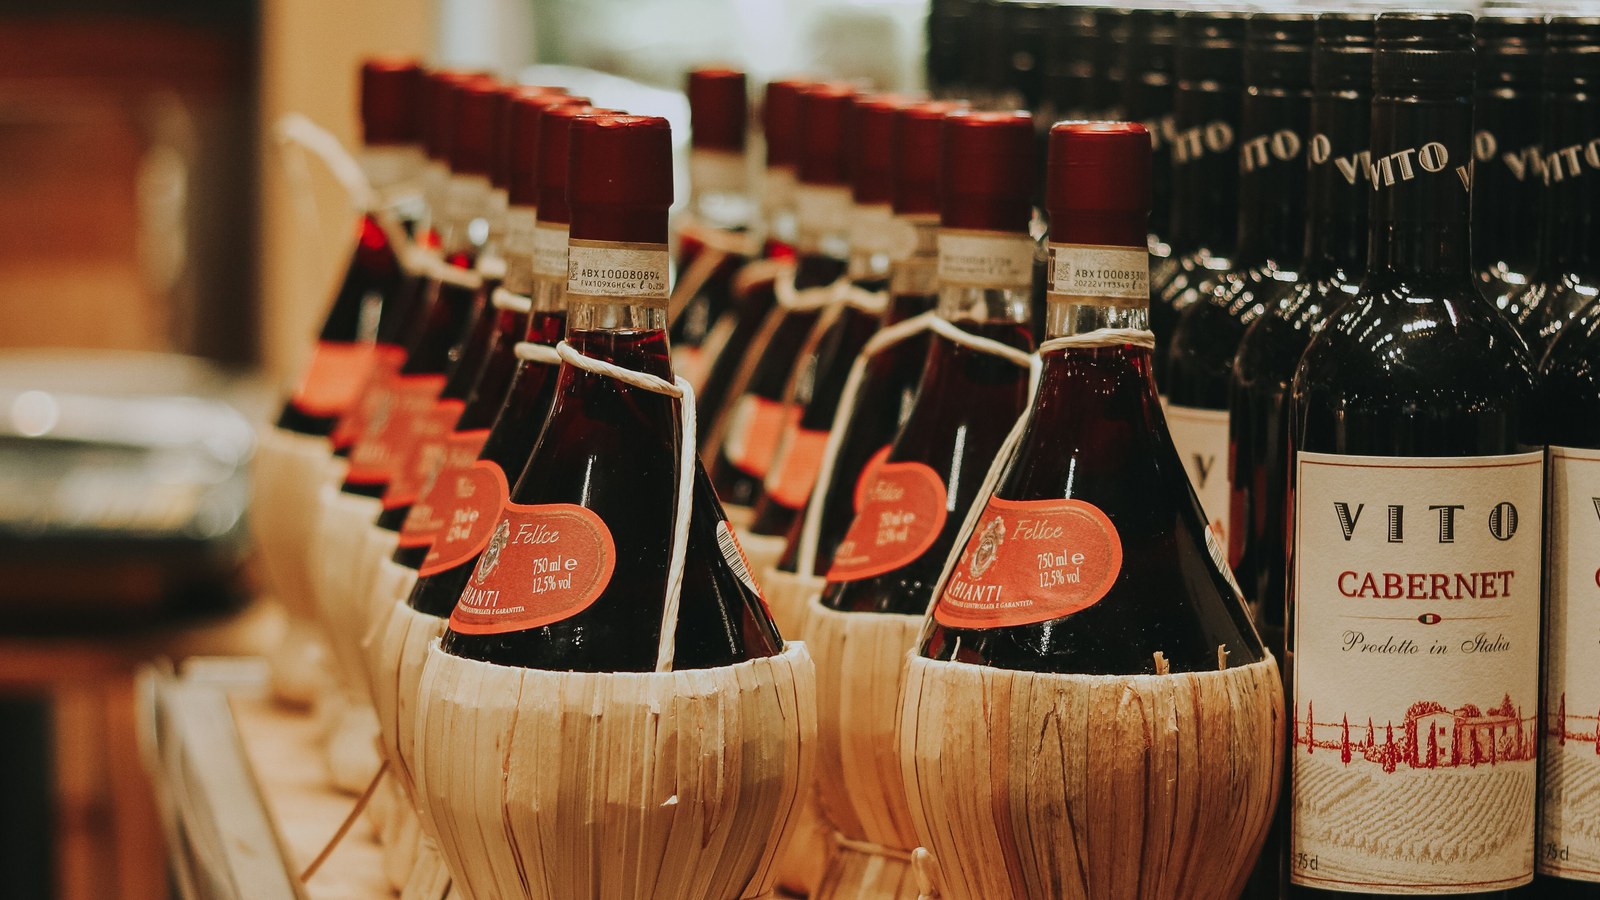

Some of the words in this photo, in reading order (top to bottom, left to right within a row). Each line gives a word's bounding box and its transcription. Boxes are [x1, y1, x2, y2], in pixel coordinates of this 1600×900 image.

[1371, 142, 1449, 192] VITO
[1333, 501, 1519, 543] VITO
[533, 557, 548, 575] 750
[550, 555, 561, 571] ml
[1037, 552, 1054, 570] 750
[1055, 549, 1067, 567] ml
[532, 575, 556, 594] 12,5%
[558, 572, 571, 589] vol
[1039, 569, 1065, 588] 12,5%
[1066, 566, 1080, 584] vol
[1337, 570, 1514, 600] CABERNET
[462, 584, 500, 607] HIANTI
[1342, 630, 1420, 655] Prodotto
[1429, 638, 1448, 655] in
[1460, 632, 1511, 654] Italia
[1297, 854, 1308, 870] 75
[1309, 855, 1319, 871] cl
[1546, 843, 1557, 860] 75
[1559, 846, 1569, 861] cl
